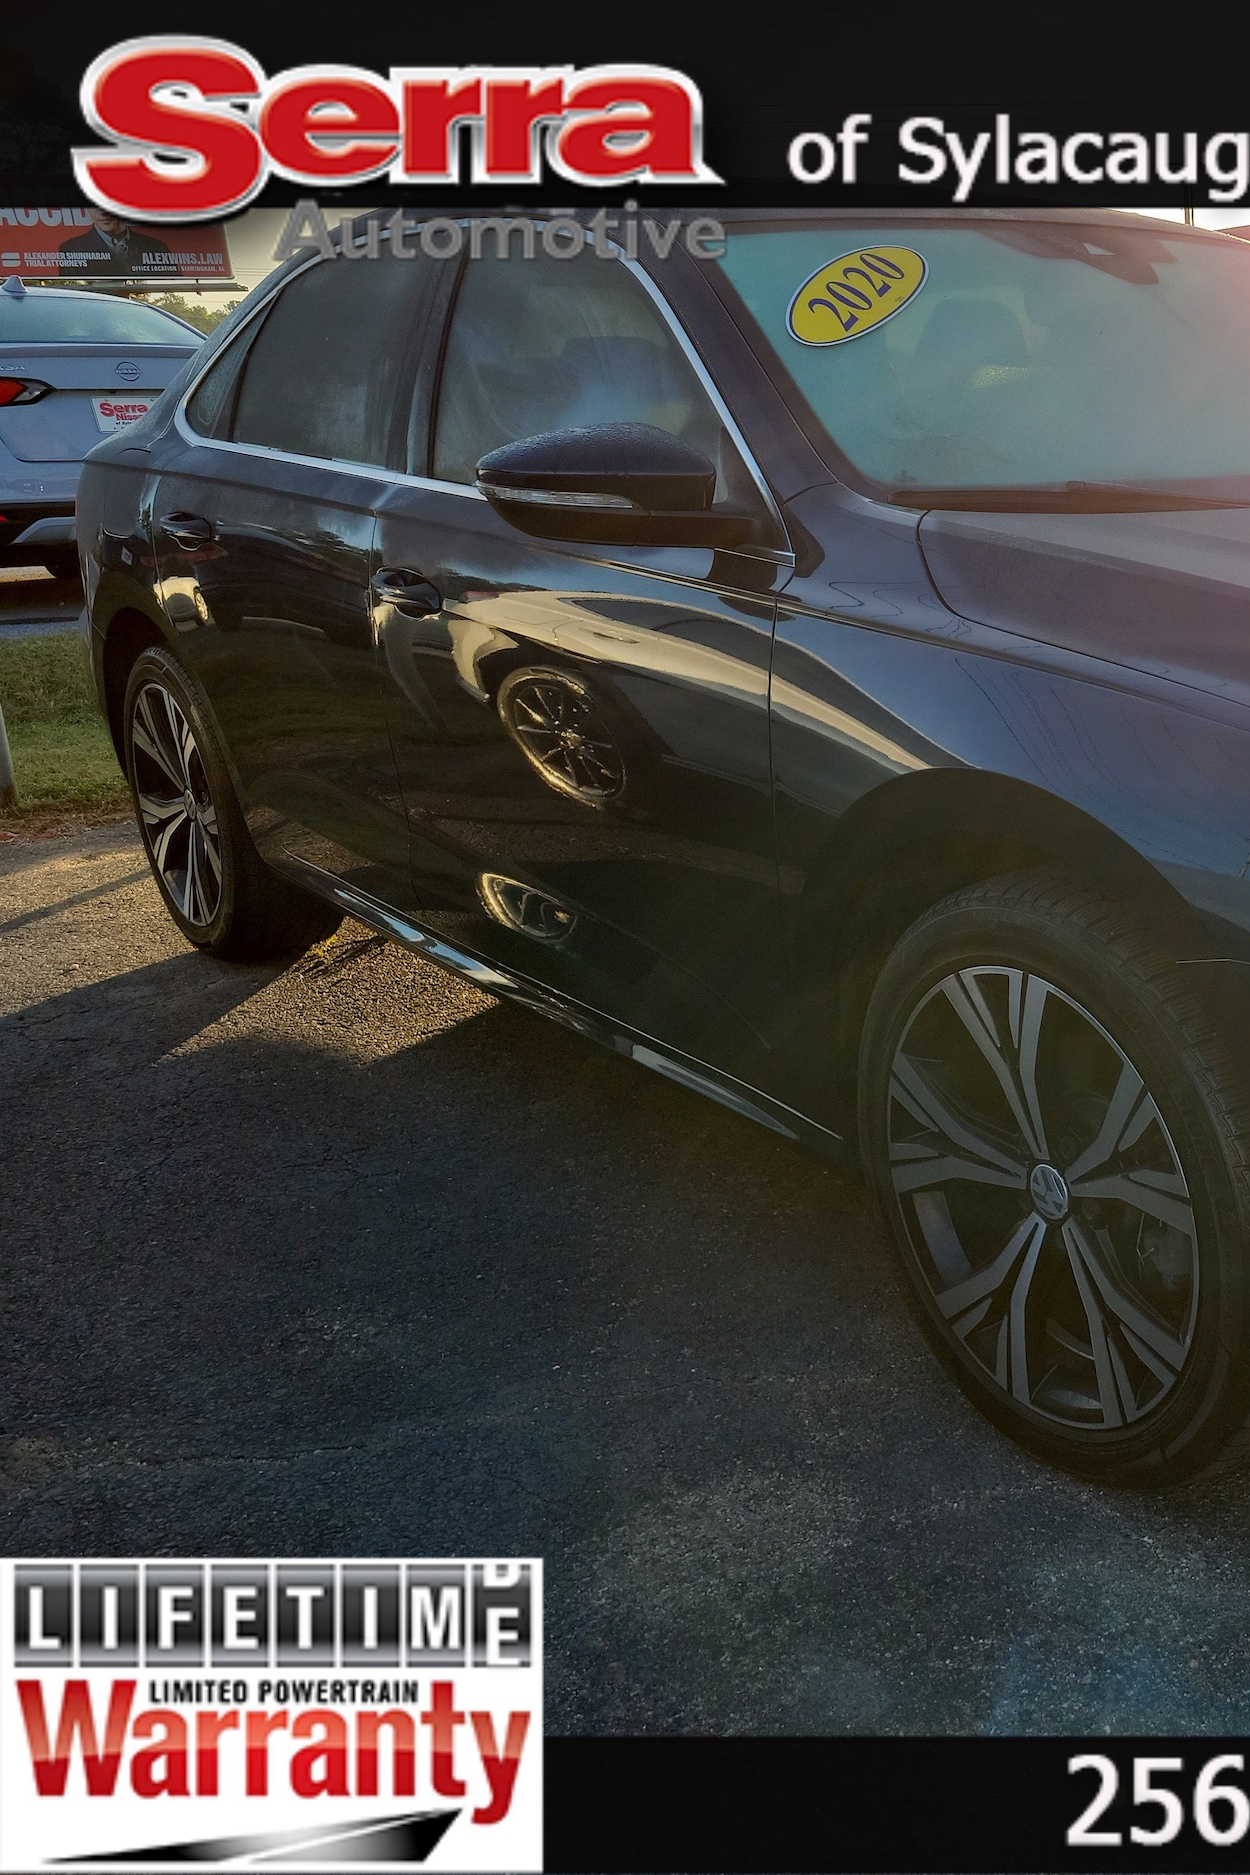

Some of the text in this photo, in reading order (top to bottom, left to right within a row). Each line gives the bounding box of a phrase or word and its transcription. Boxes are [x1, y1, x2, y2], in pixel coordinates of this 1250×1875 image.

[24, 252, 66, 260] ALEXANDER
[142, 252, 223, 265] ALEXWINS.LAW
[808, 253, 905, 332] 2020
[99, 402, 149, 417] Serra
